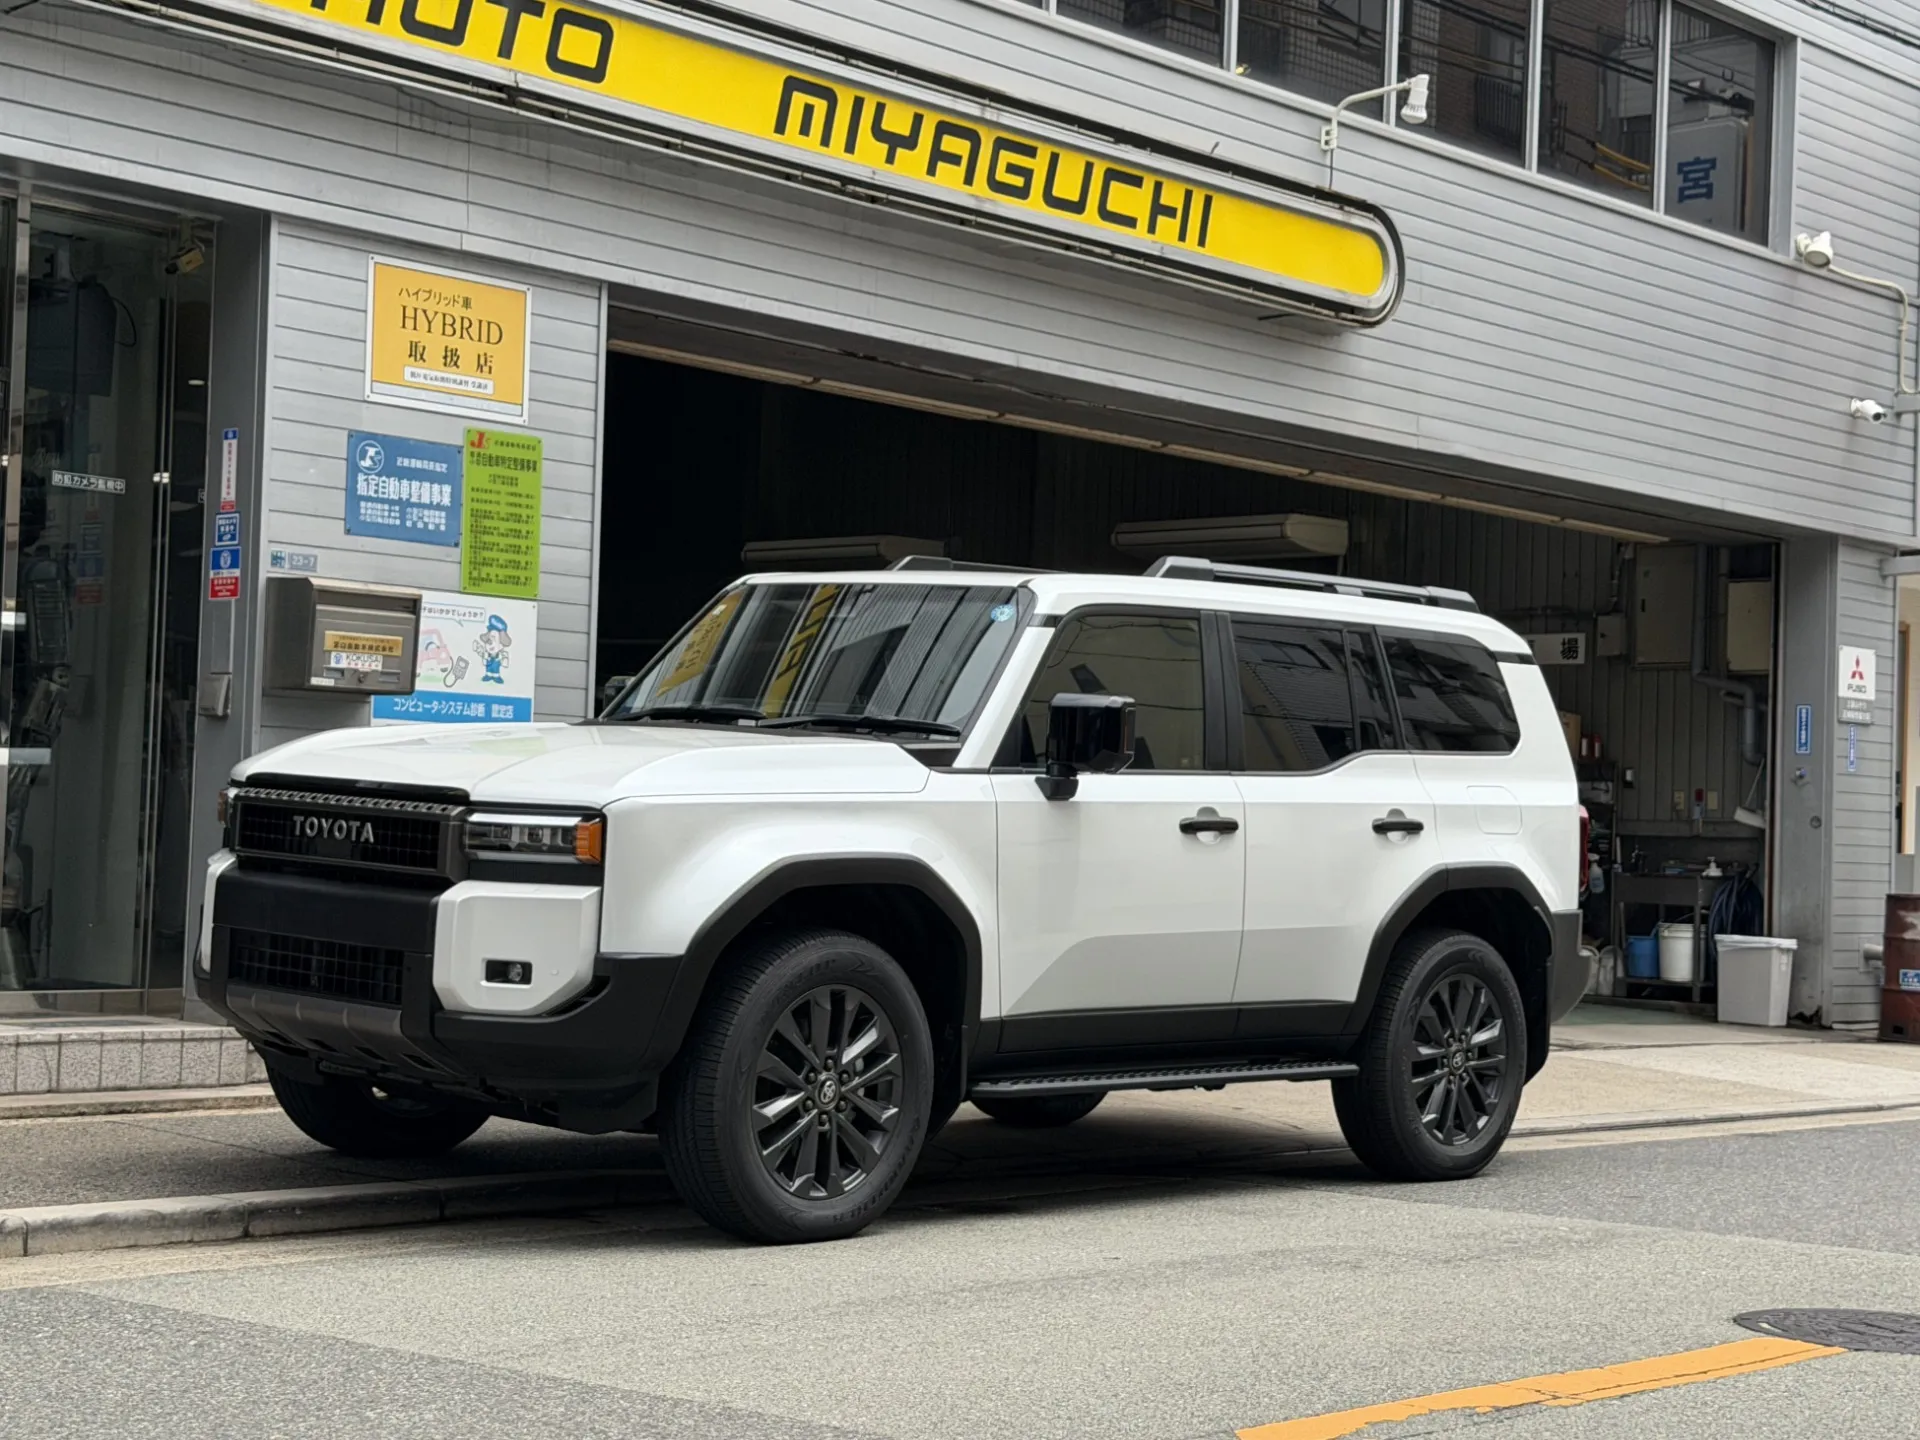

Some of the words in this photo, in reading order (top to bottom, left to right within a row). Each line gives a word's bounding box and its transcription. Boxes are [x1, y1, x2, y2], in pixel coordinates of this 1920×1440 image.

[773, 75, 1214, 249] MIYAGUCHI
[1676, 156, 1718, 205] 宮
[399, 287, 473, 311] ハイブリッド車
[400, 304, 504, 346] HYBRID
[292, 814, 375, 845] TOYOTA
